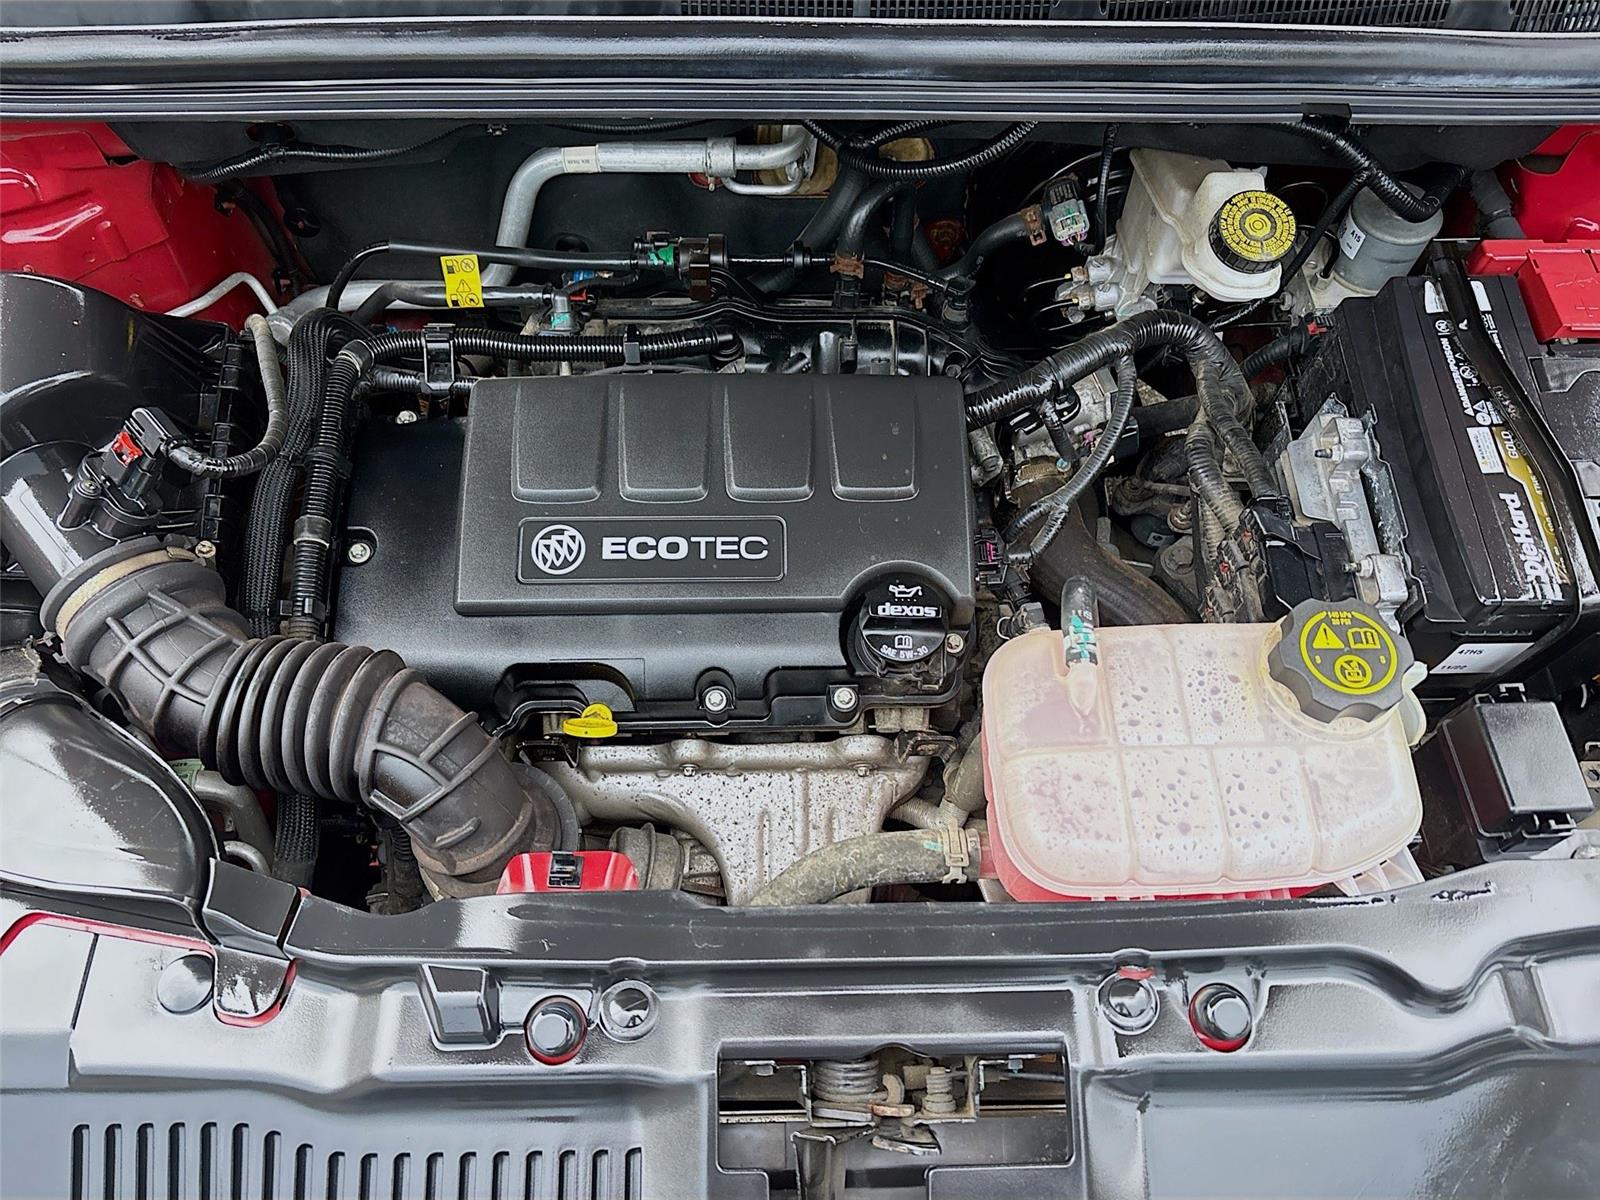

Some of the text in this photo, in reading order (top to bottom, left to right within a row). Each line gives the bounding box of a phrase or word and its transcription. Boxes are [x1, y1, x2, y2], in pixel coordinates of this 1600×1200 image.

[1501, 430, 1519, 459] GOLD
[602, 536, 769, 560] ECOTEC
[1499, 491, 1551, 584] DieHard
[877, 602, 938, 617] dexos
[880, 644, 929, 659] SAE 5W-30
